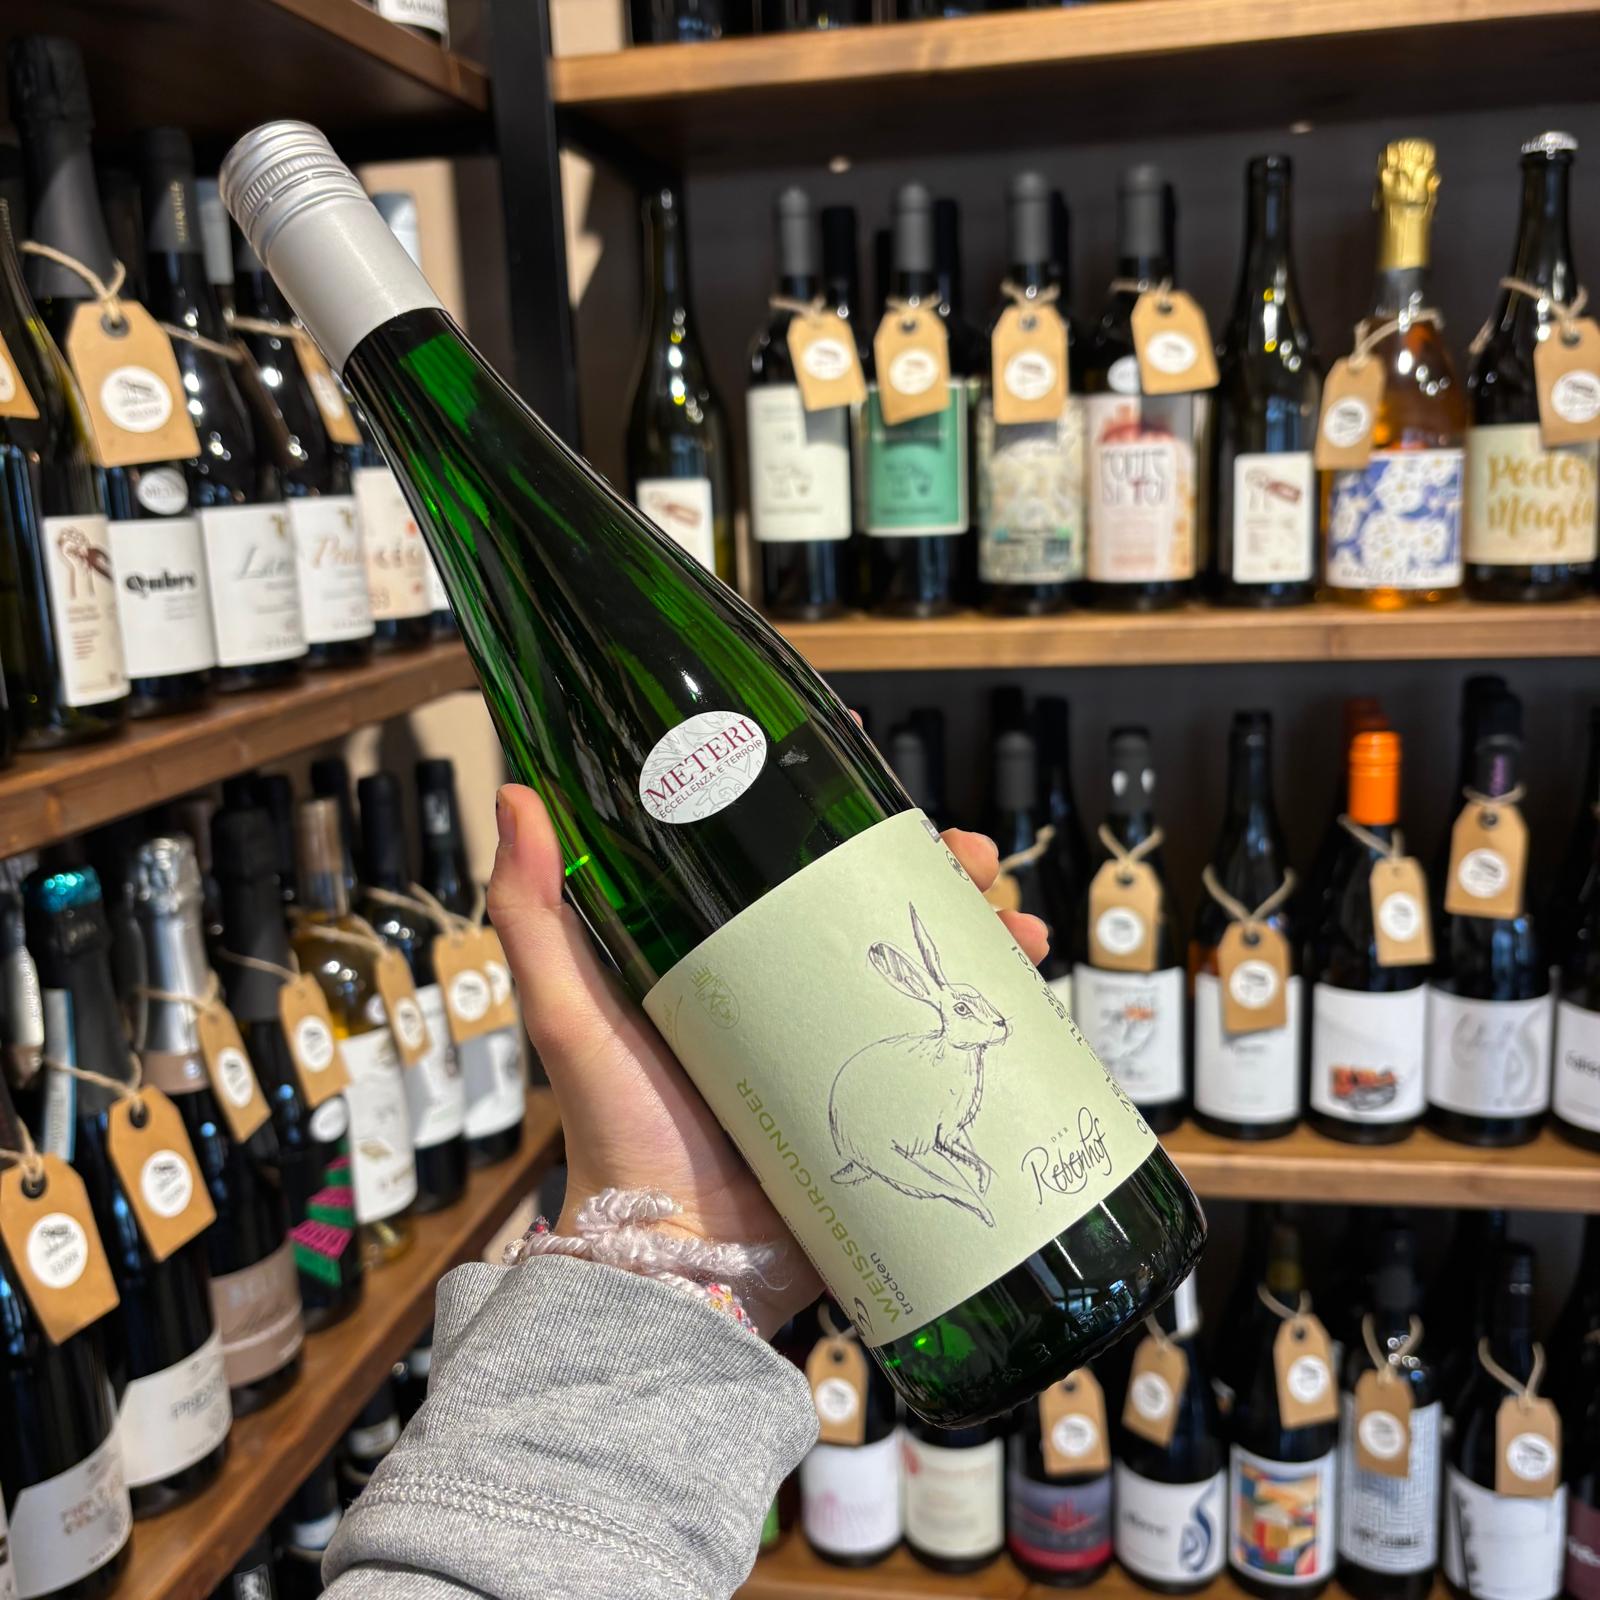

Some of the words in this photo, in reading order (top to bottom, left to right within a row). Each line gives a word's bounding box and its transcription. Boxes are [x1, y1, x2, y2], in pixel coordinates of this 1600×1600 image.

[645, 719, 757, 809] METERI
[659, 771, 717, 819] ECCELLENZA
[717, 765, 726, 774] E
[725, 739, 764, 768] TERROIR
[1021, 1106, 1113, 1206] Rebenhof
[1050, 1126, 1069, 1143] DER
[736, 1078, 900, 1324] WEISSBURGUNDER
[870, 1251, 914, 1316] trocken
